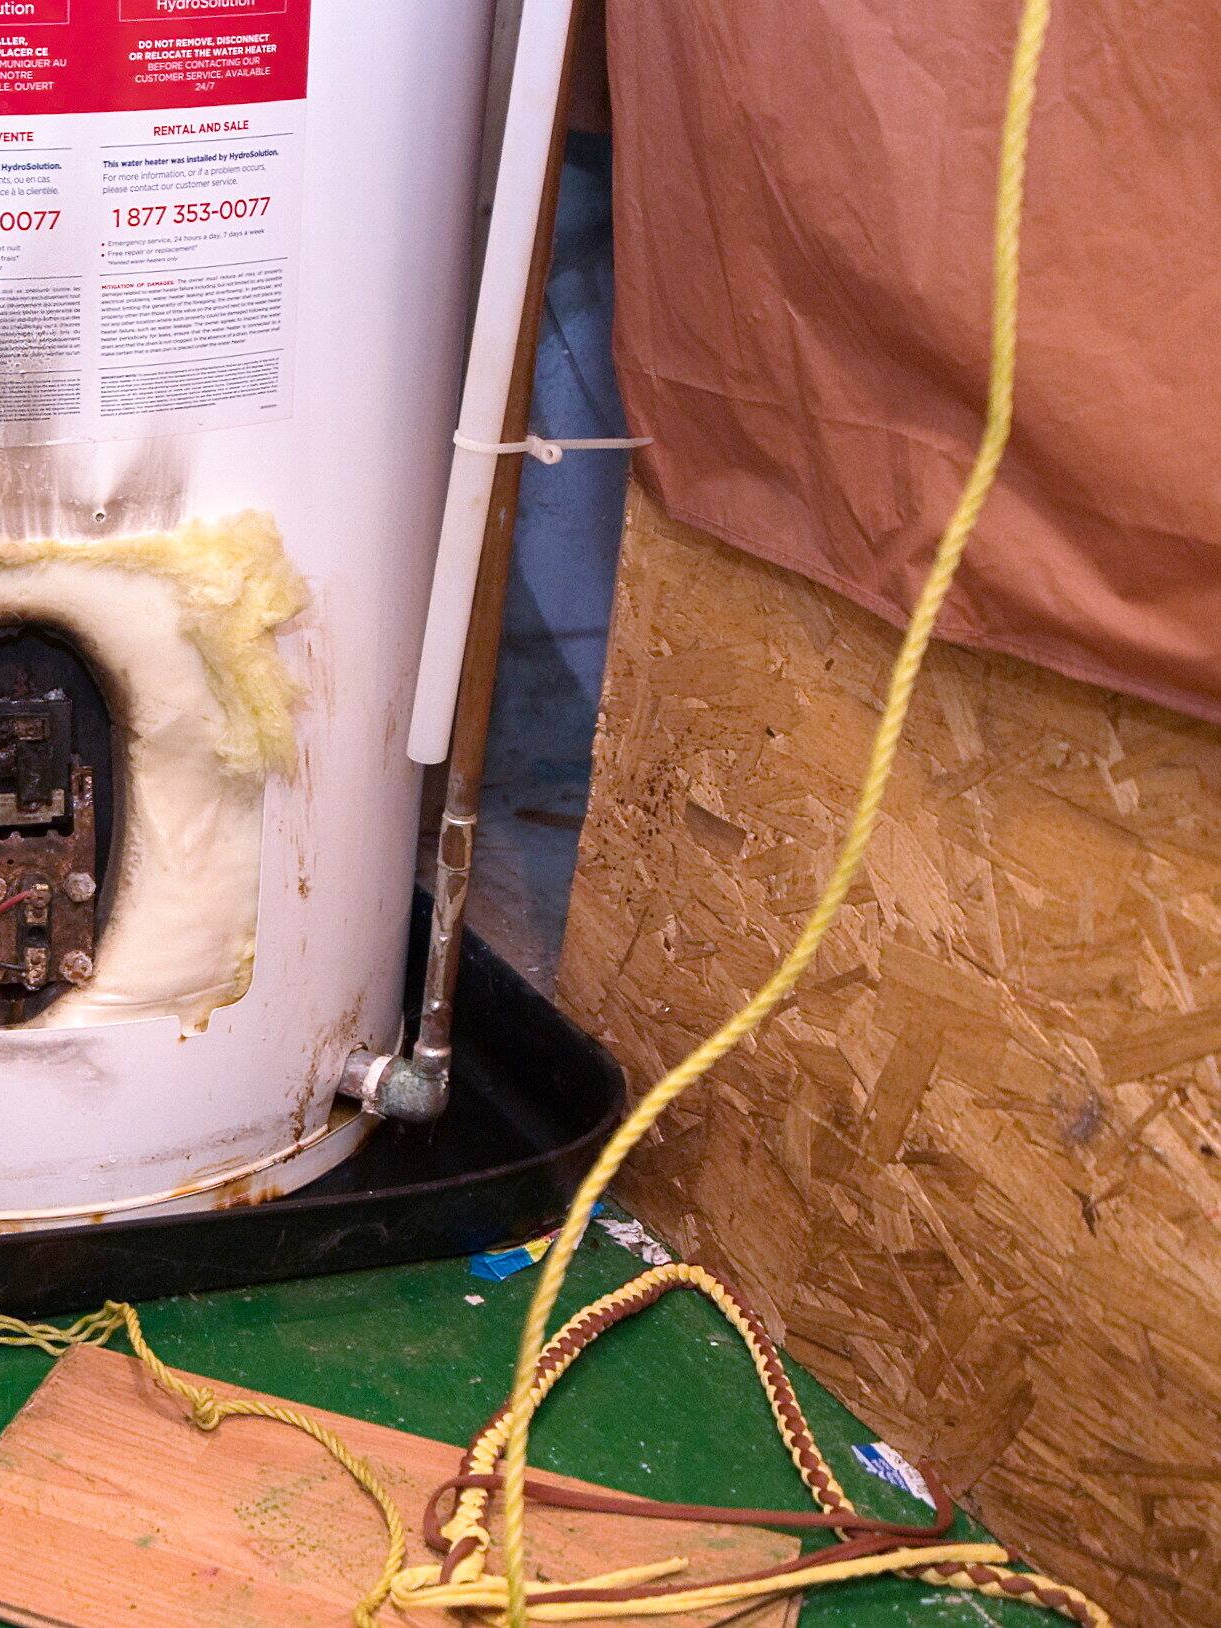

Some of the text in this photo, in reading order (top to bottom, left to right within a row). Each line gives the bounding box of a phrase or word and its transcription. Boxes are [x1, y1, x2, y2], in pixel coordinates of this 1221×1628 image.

[157, 0, 254, 11] HydroSolution
[138, 34, 269, 48] DO NOT REMOVE, DISCONNECT
[35, 48, 47, 56] CE
[128, 44, 276, 60] OR RELOCATE THE WATER HEATER
[52, 59, 66, 67] AU
[147, 56, 259, 71] BEFORE CONTACTING OUR
[135, 72, 183, 82] CUSTOMER
[225, 67, 269, 78] AVAILABLE
[14, 81, 53, 90] OUVERT
[195, 81, 215, 91] 24/7
[154, 120, 248, 135] RENTAL AND SALE
[103, 160, 118, 168] This
[121, 158, 142, 167] water
[144, 157, 168, 165] heater
[186, 153, 216, 162] installed
[218, 153, 227, 161] by
[229, 149, 278, 160] HydroSolution.
[1, 162, 61, 171] HydroSolution.
[103, 173, 116, 181] For
[198, 168, 202, 176] if
[210, 165, 240, 175] problem
[102, 185, 127, 194] please
[129, 183, 158, 192] contact
[160, 182, 173, 190] our
[175, 180, 209, 189] customer
[112, 196, 271, 228] 1 877 353-0077
